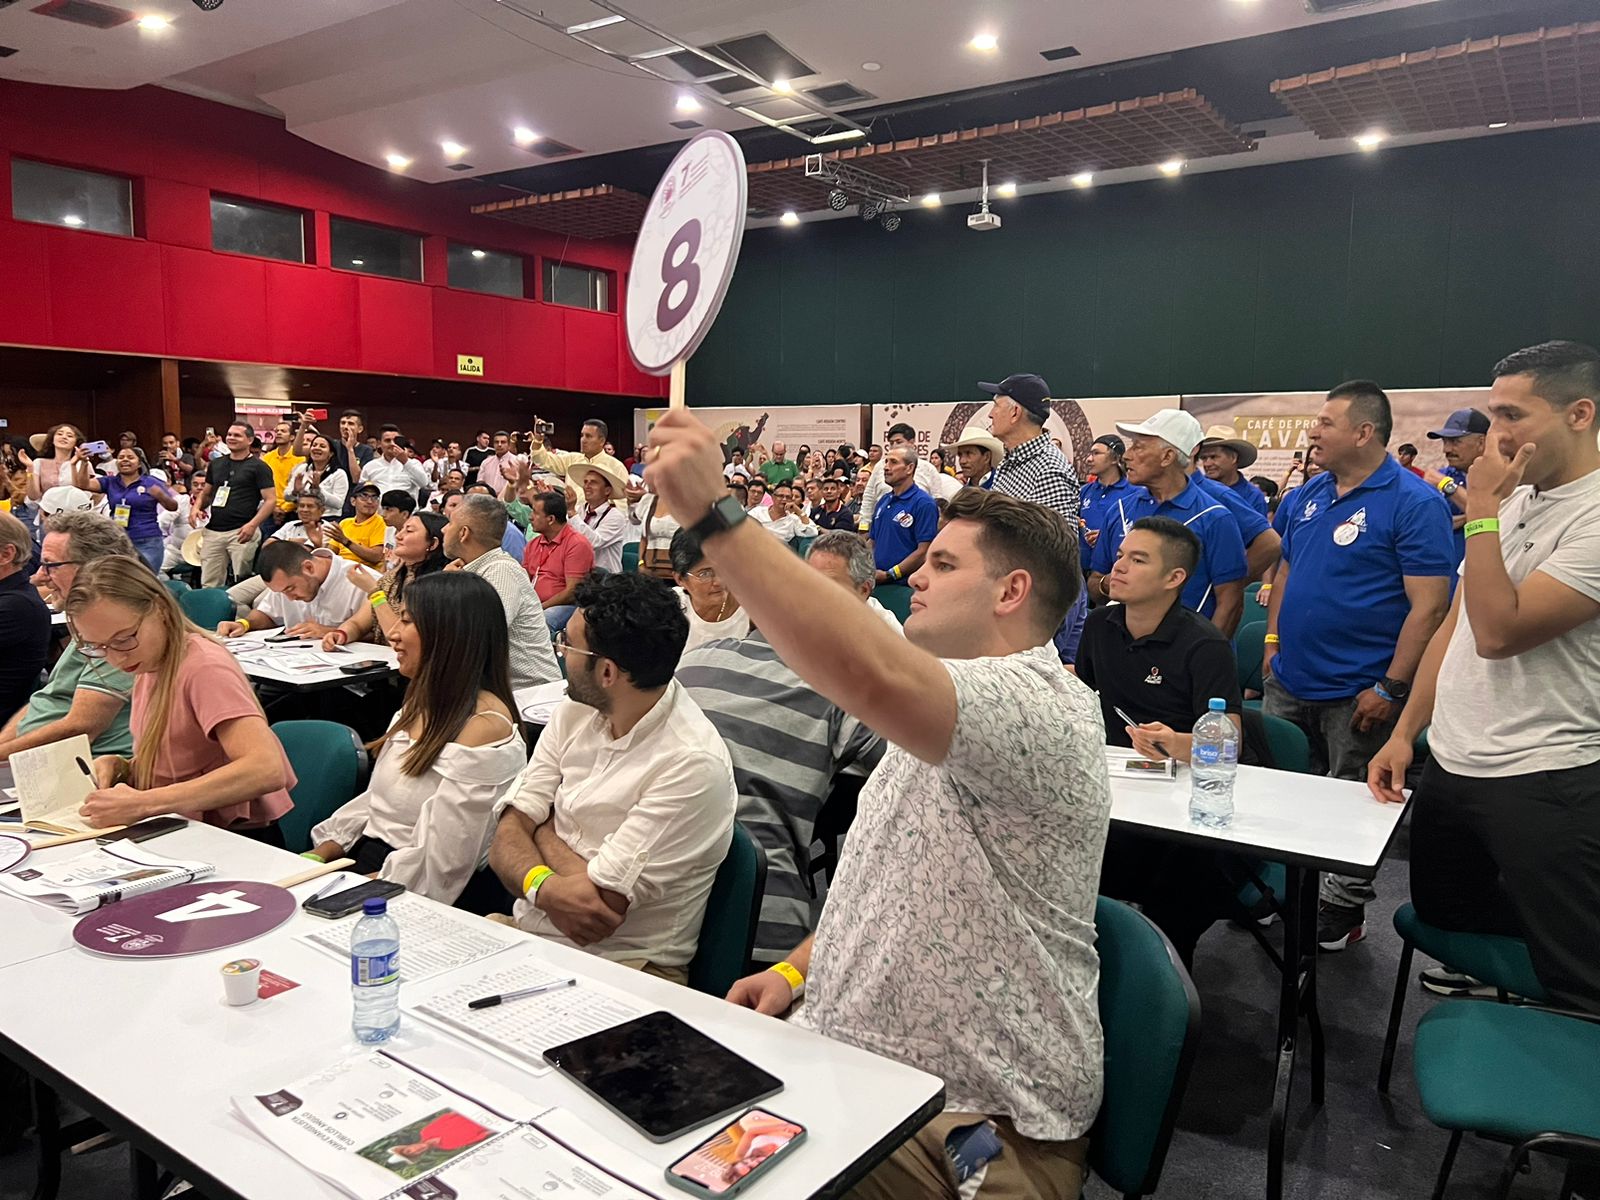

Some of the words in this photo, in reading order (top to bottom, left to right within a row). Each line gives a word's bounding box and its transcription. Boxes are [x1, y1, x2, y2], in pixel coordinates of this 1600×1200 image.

[681, 160, 693, 187] 7
[656, 218, 702, 332] 8
[460, 363, 481, 373] SALIDA
[1247, 417, 1274, 429] CAFÉ
[1279, 419, 1293, 429] DE
[918, 431, 931, 442] DE
[154, 889, 262, 923] 4
[104, 934, 131, 943] 7
[291, 1115, 329, 1142] EVANGELISTA
[325, 1125, 355, 1146] CUBILLOS
